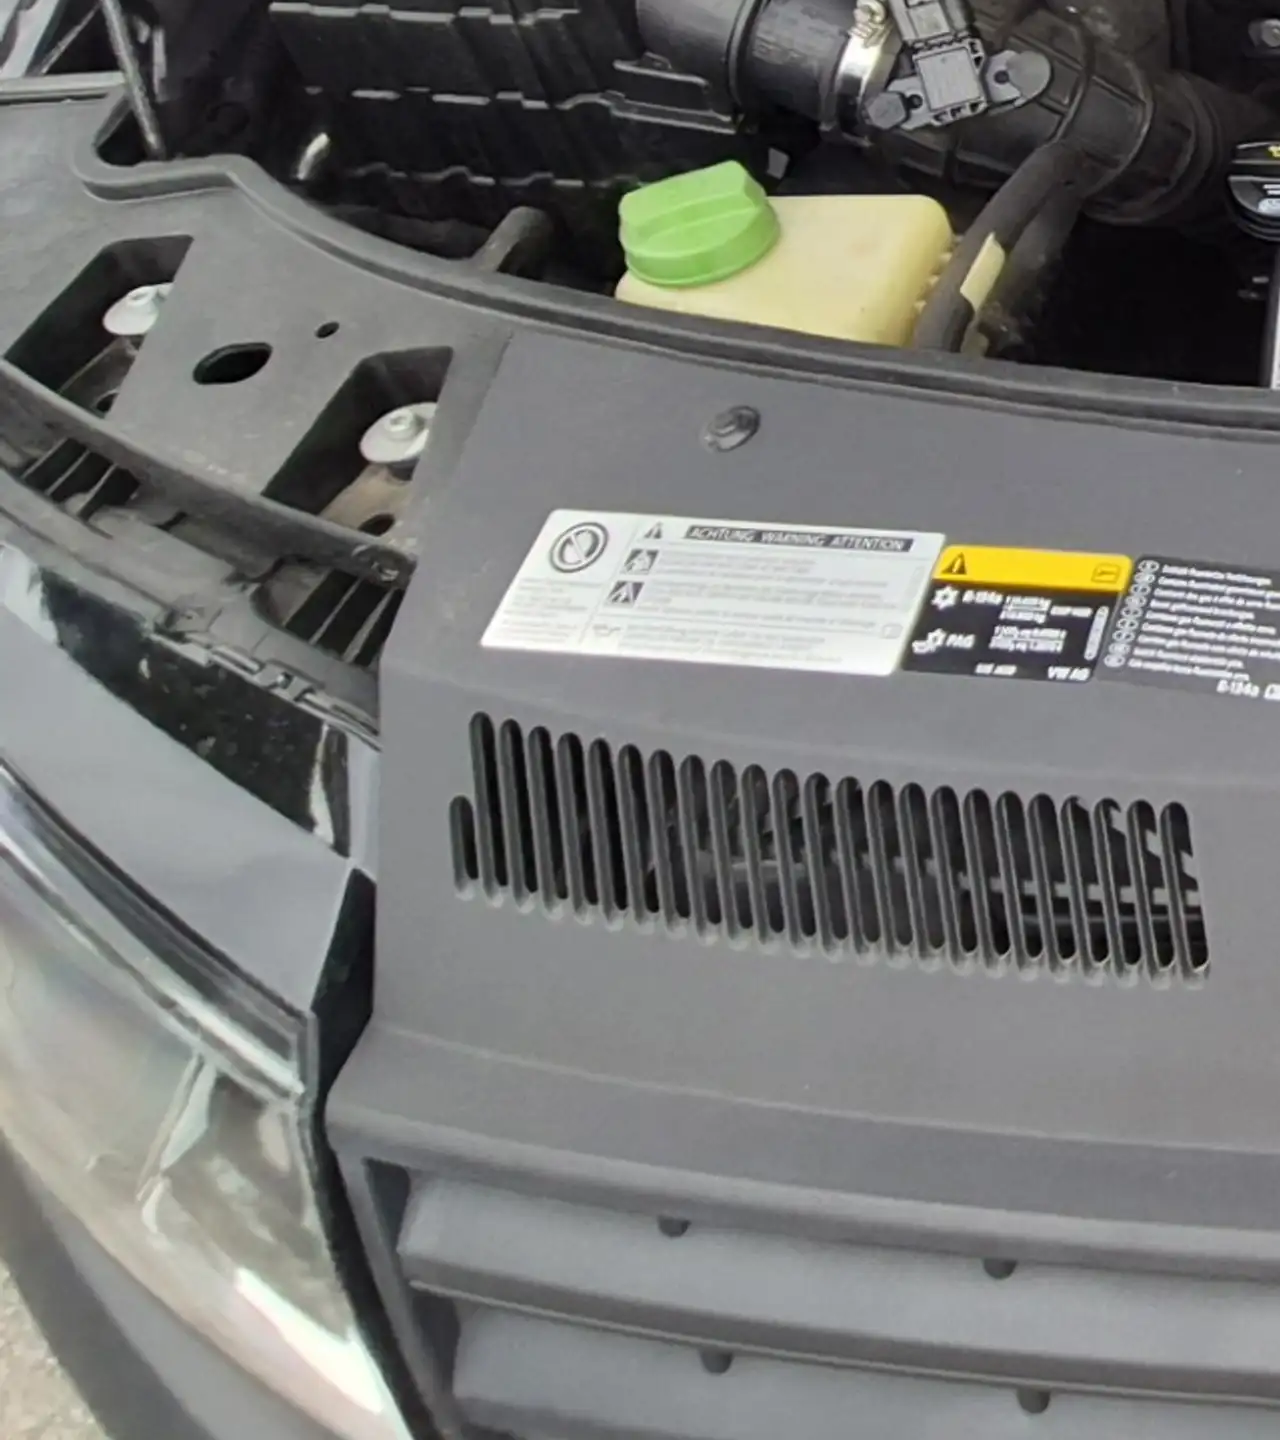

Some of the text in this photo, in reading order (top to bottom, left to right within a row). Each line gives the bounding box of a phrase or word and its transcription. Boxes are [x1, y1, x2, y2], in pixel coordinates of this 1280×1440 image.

[691, 526, 905, 551] ACHTUNG WARNING ATTENTION
